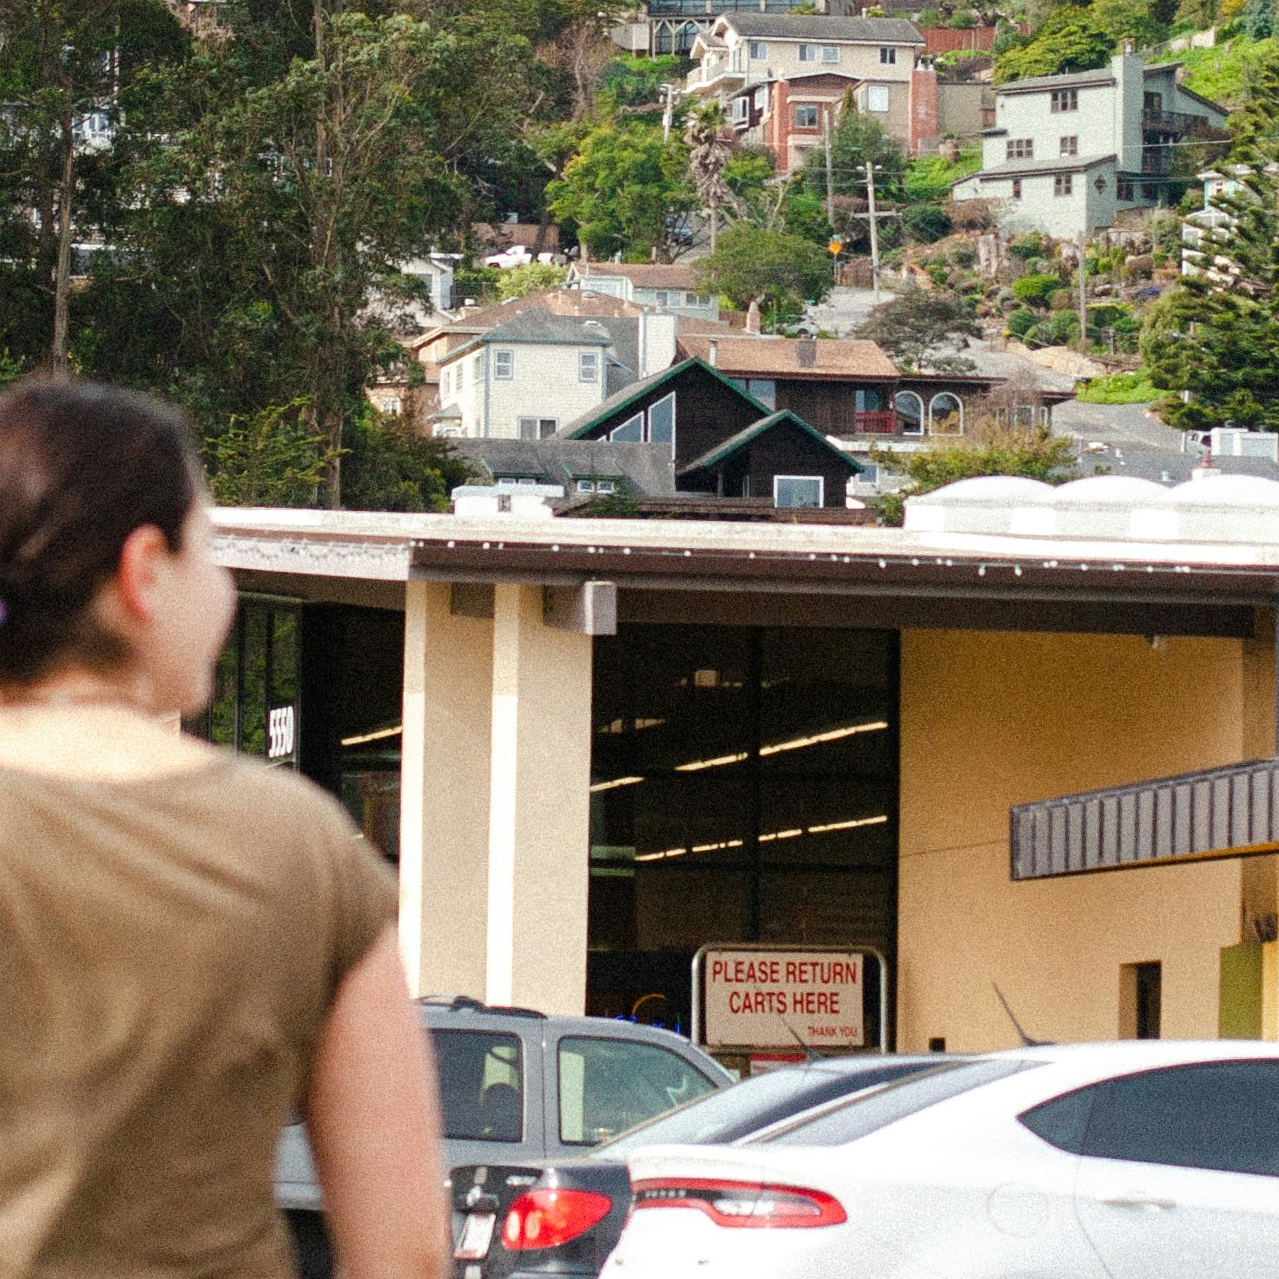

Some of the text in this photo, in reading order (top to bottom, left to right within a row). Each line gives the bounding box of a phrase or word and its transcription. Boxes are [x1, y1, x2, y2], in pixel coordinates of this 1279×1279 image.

[712, 961, 857, 985] PLEASE RETURN
[728, 991, 840, 1015] CARTS HERE
[807, 1026, 858, 1037] THANK YOU
